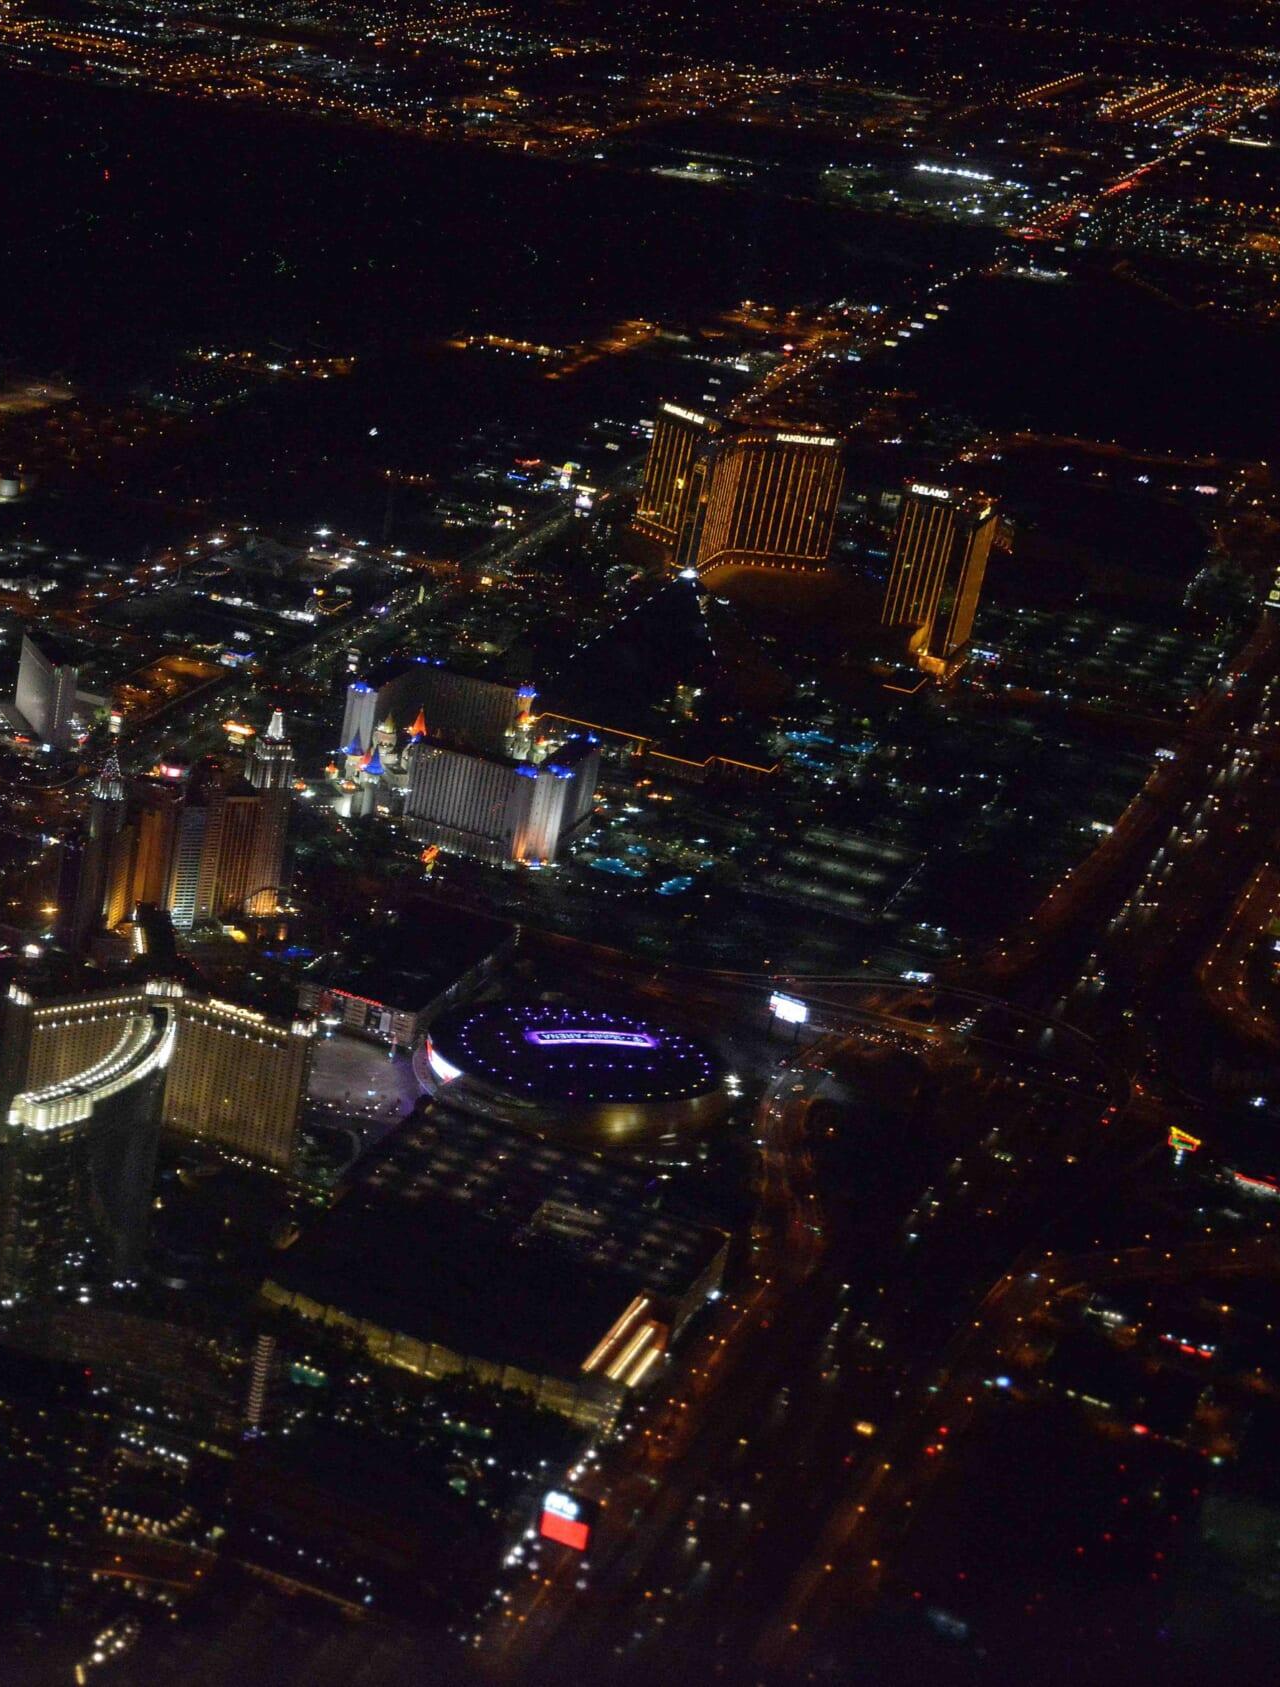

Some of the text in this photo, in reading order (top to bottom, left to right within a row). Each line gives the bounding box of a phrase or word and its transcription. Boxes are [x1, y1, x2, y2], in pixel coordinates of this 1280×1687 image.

[776, 433, 836, 446] MANDALAY BAY
[912, 484, 949, 498] DELANO
